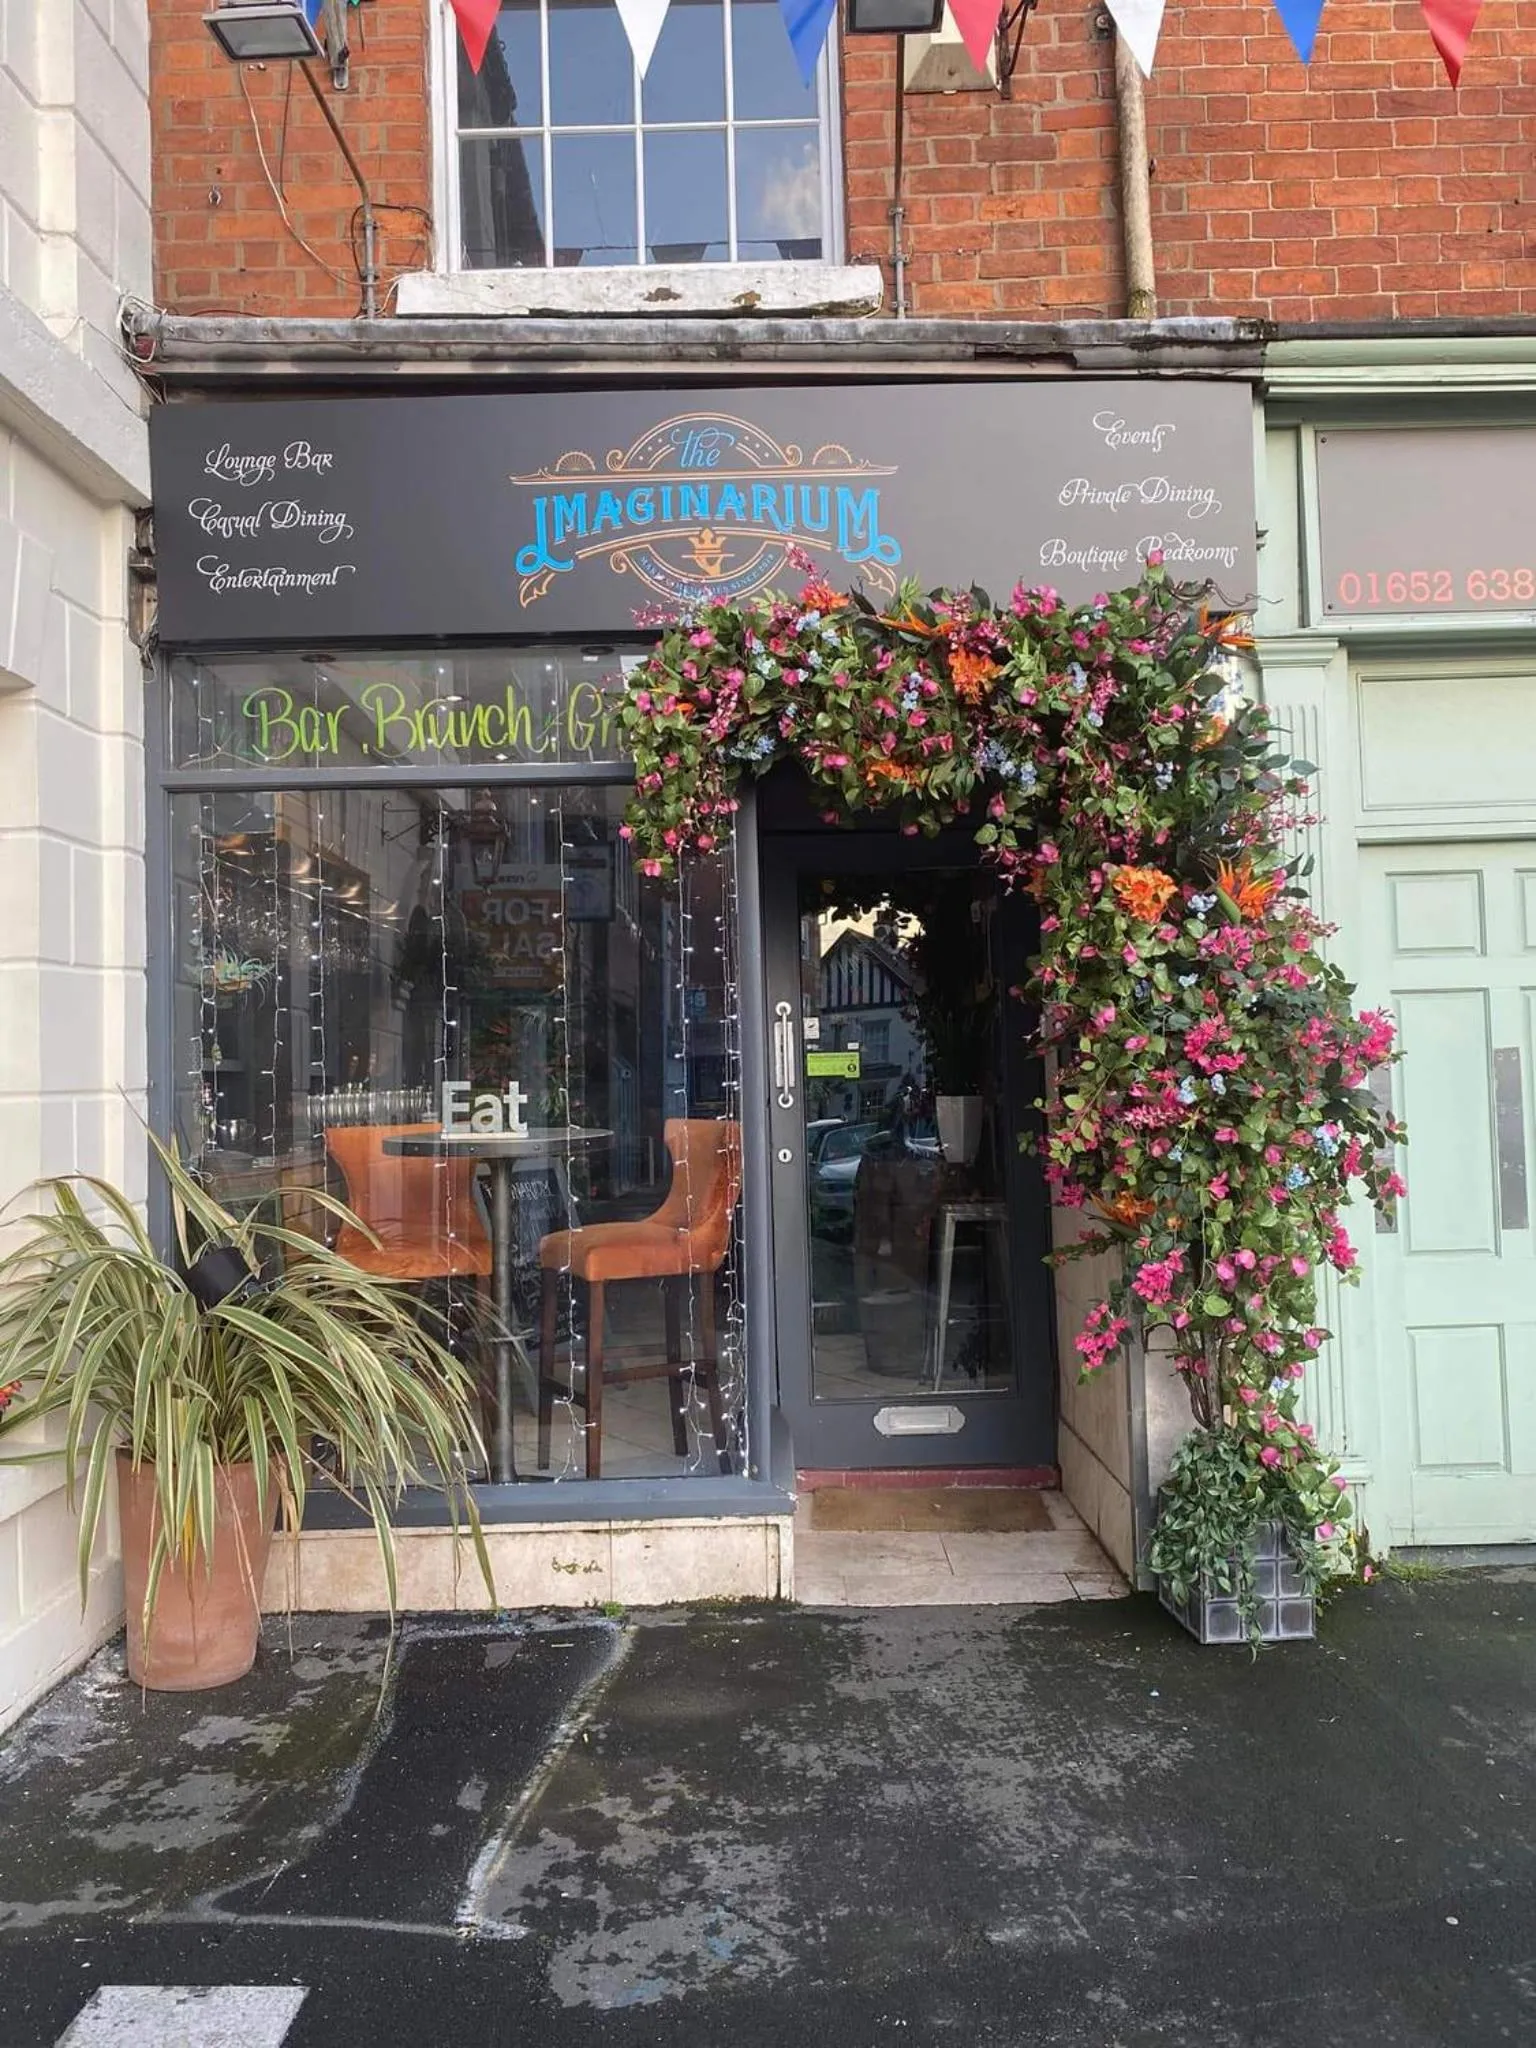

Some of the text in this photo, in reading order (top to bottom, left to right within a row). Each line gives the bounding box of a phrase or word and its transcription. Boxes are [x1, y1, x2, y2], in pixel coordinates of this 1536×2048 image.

[671, 426, 735, 469] the
[1093, 410, 1176, 453] Events
[204, 440, 333, 487] Lounge Bar
[1058, 476, 1222, 519] Private Dining
[188, 498, 354, 544] Casual Dining
[515, 484, 902, 577] IMAGINARIUM
[196, 555, 356, 597] Entertainment
[1040, 538, 1129, 573] Boutique
[1339, 570, 1454, 605] 01652
[242, 686, 351, 760] Bar
[360, 682, 549, 759] Brunch
[442, 1080, 528, 1133] Eat
